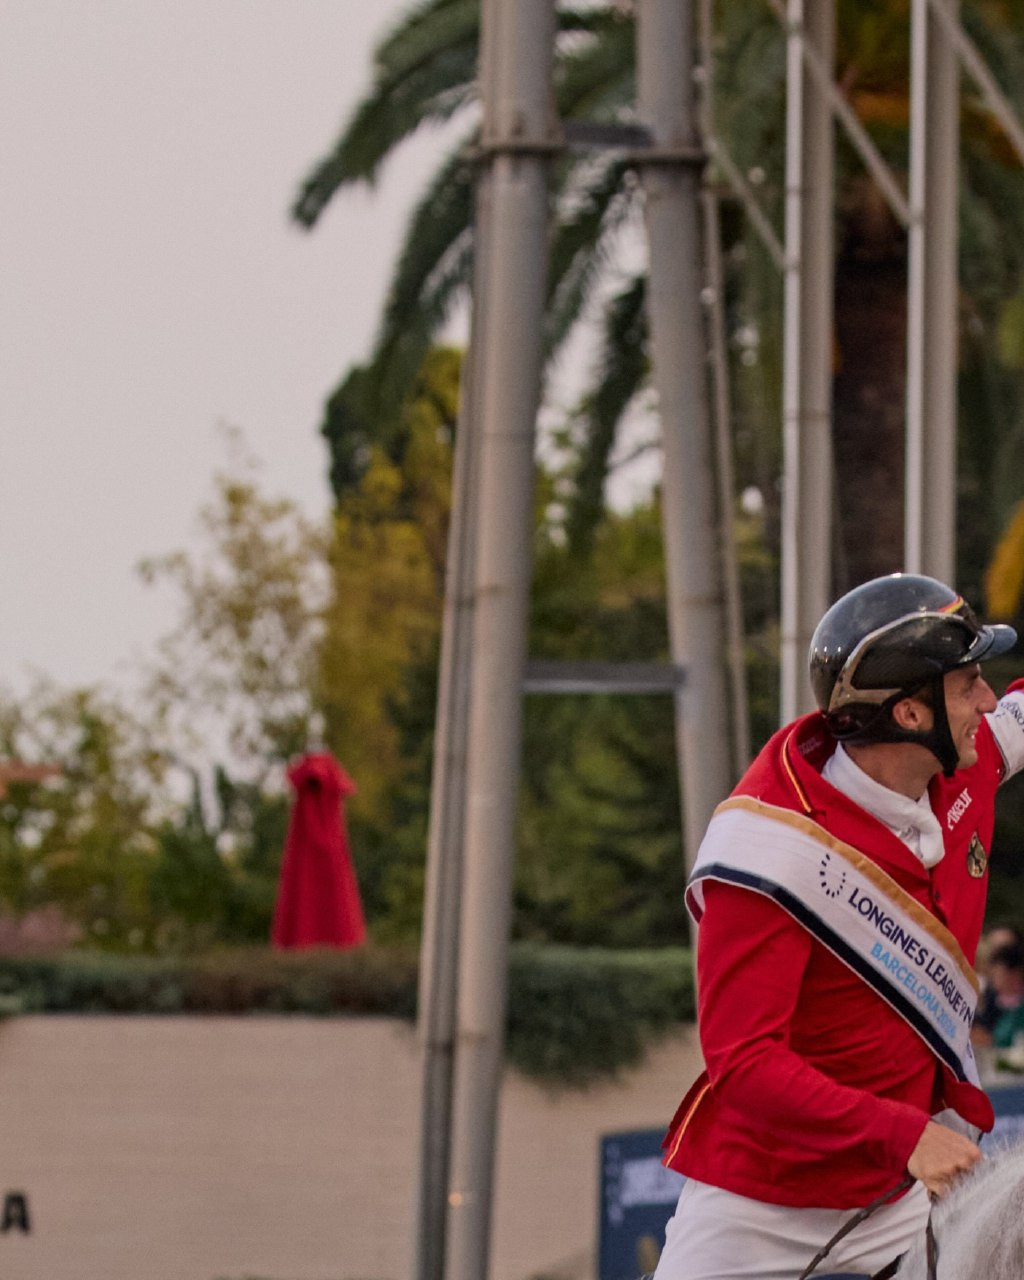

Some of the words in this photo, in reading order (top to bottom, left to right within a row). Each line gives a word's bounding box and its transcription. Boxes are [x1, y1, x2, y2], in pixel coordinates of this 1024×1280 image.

[848, 888, 929, 966] LONGINES
[925, 957, 963, 1013] LEAGUE
[871, 943, 940, 1014] BARCELONA
